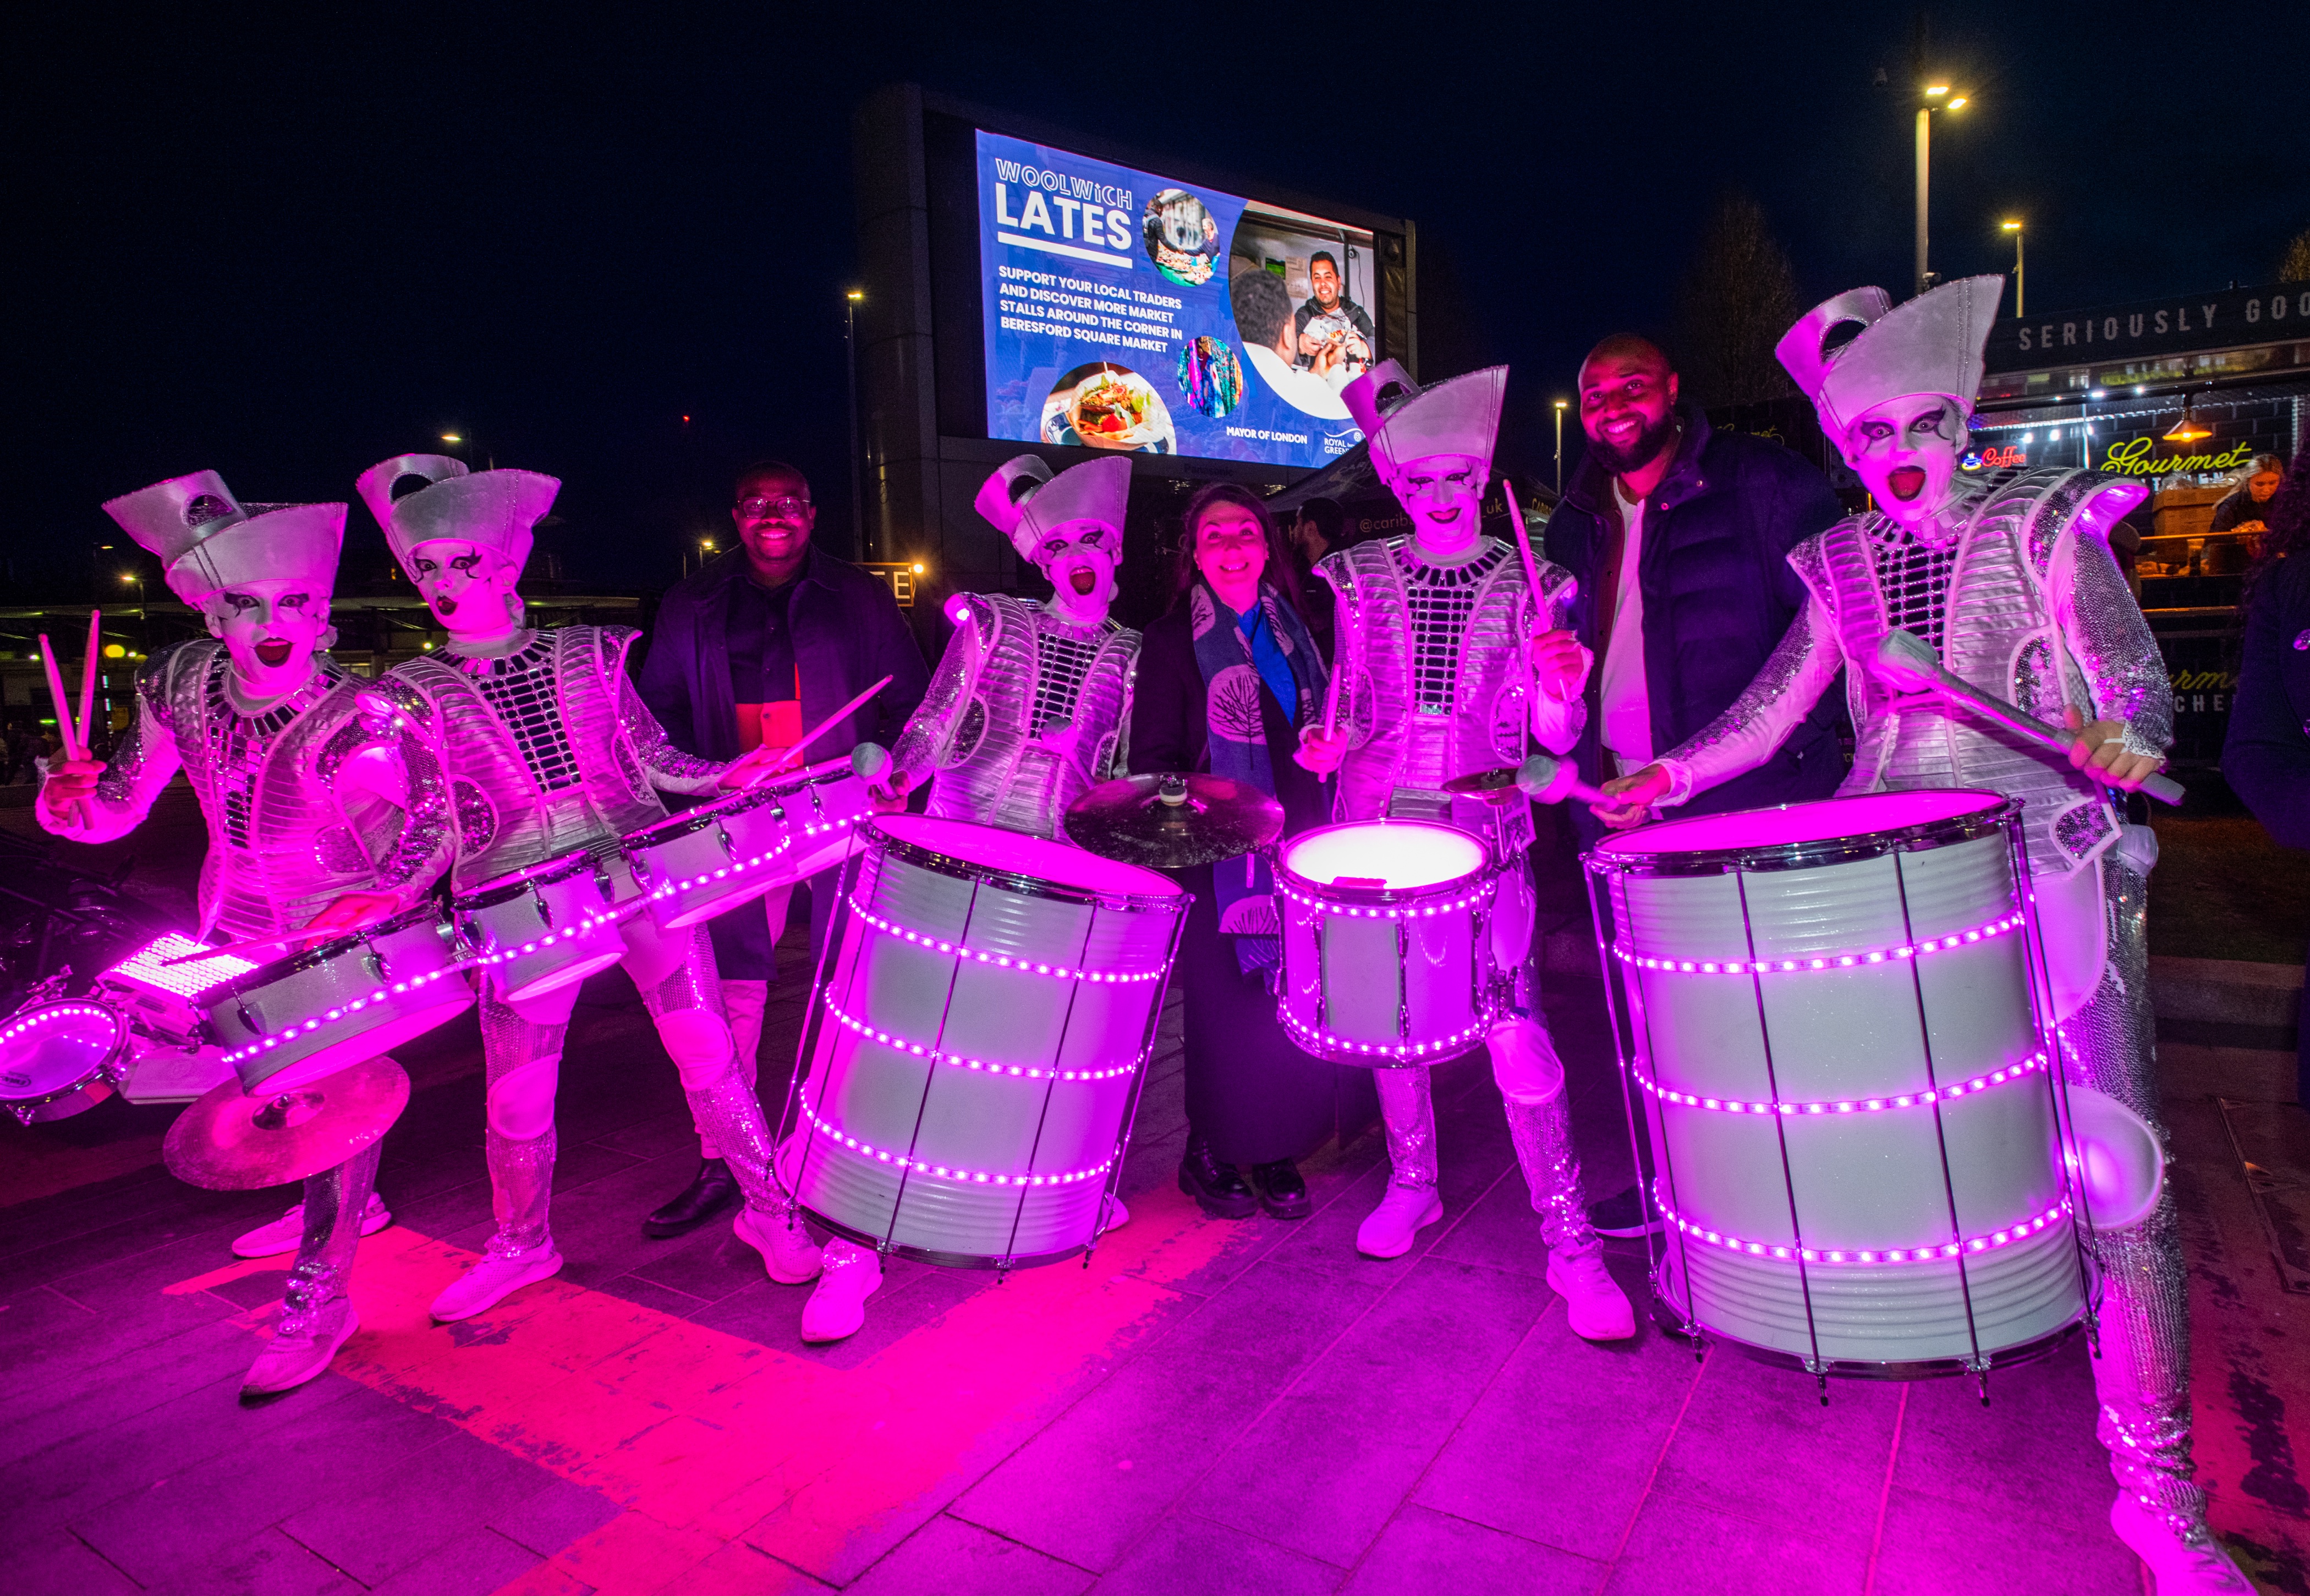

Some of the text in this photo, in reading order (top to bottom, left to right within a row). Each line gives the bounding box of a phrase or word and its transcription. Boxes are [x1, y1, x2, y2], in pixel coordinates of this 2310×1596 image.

[996, 182, 1132, 250] LATES
[998, 265, 1182, 309] SUPPORT YOUR LOCAL TRADERS
[1000, 283, 1174, 323] AND DISCOVER MORE MARKET
[1000, 300, 1182, 340] STALLS AROUND THE CORNER IN
[1001, 316, 1168, 353] BERESFORD SQUARE MARKET
[2018, 304, 2218, 350] SERIOUSLY
[1226, 426, 1307, 445] MAYOR OF LONDON
[1324, 437, 1347, 447] ROYAL
[1982, 446, 2026, 468] Coffee
[2101, 437, 2253, 475] Gourmet
